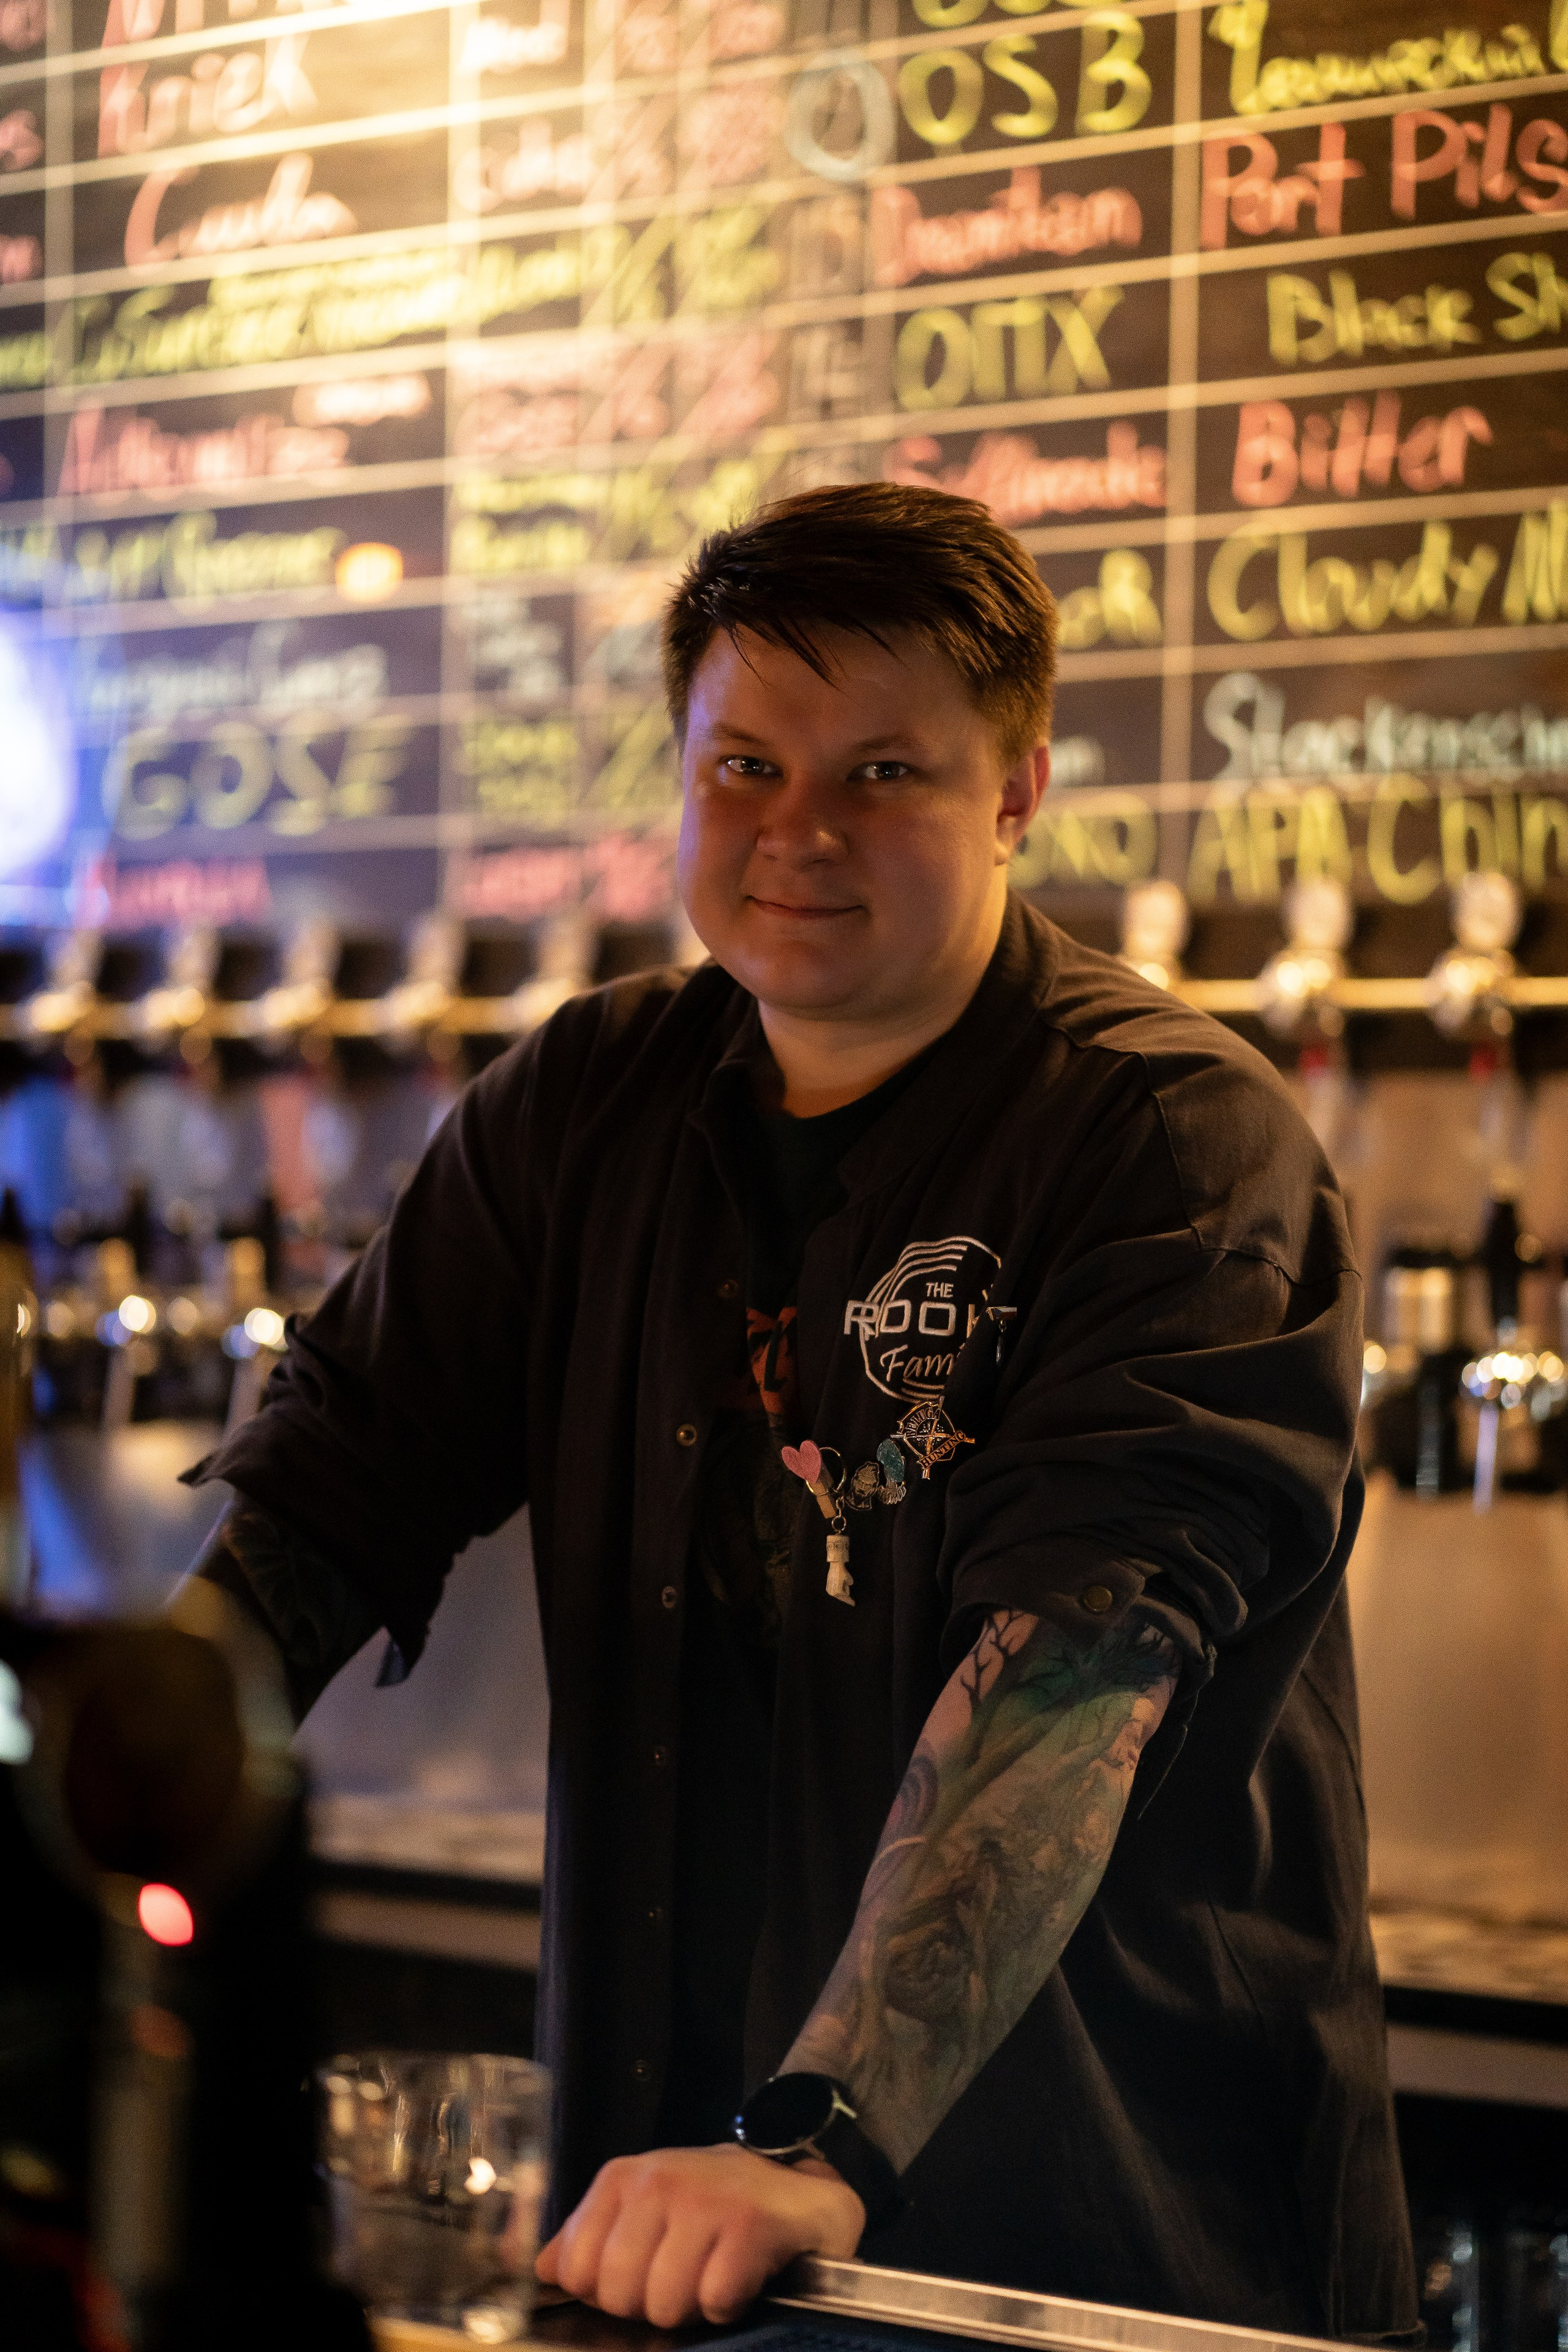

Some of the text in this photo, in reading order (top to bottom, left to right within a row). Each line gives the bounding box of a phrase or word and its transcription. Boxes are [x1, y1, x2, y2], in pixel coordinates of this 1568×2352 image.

[925, 1281, 954, 1298] THE
[880, 1343, 965, 1382] Fam
[905, 1406, 941, 1437] BELUGA
[920, 1431, 966, 1468] HUNTING
